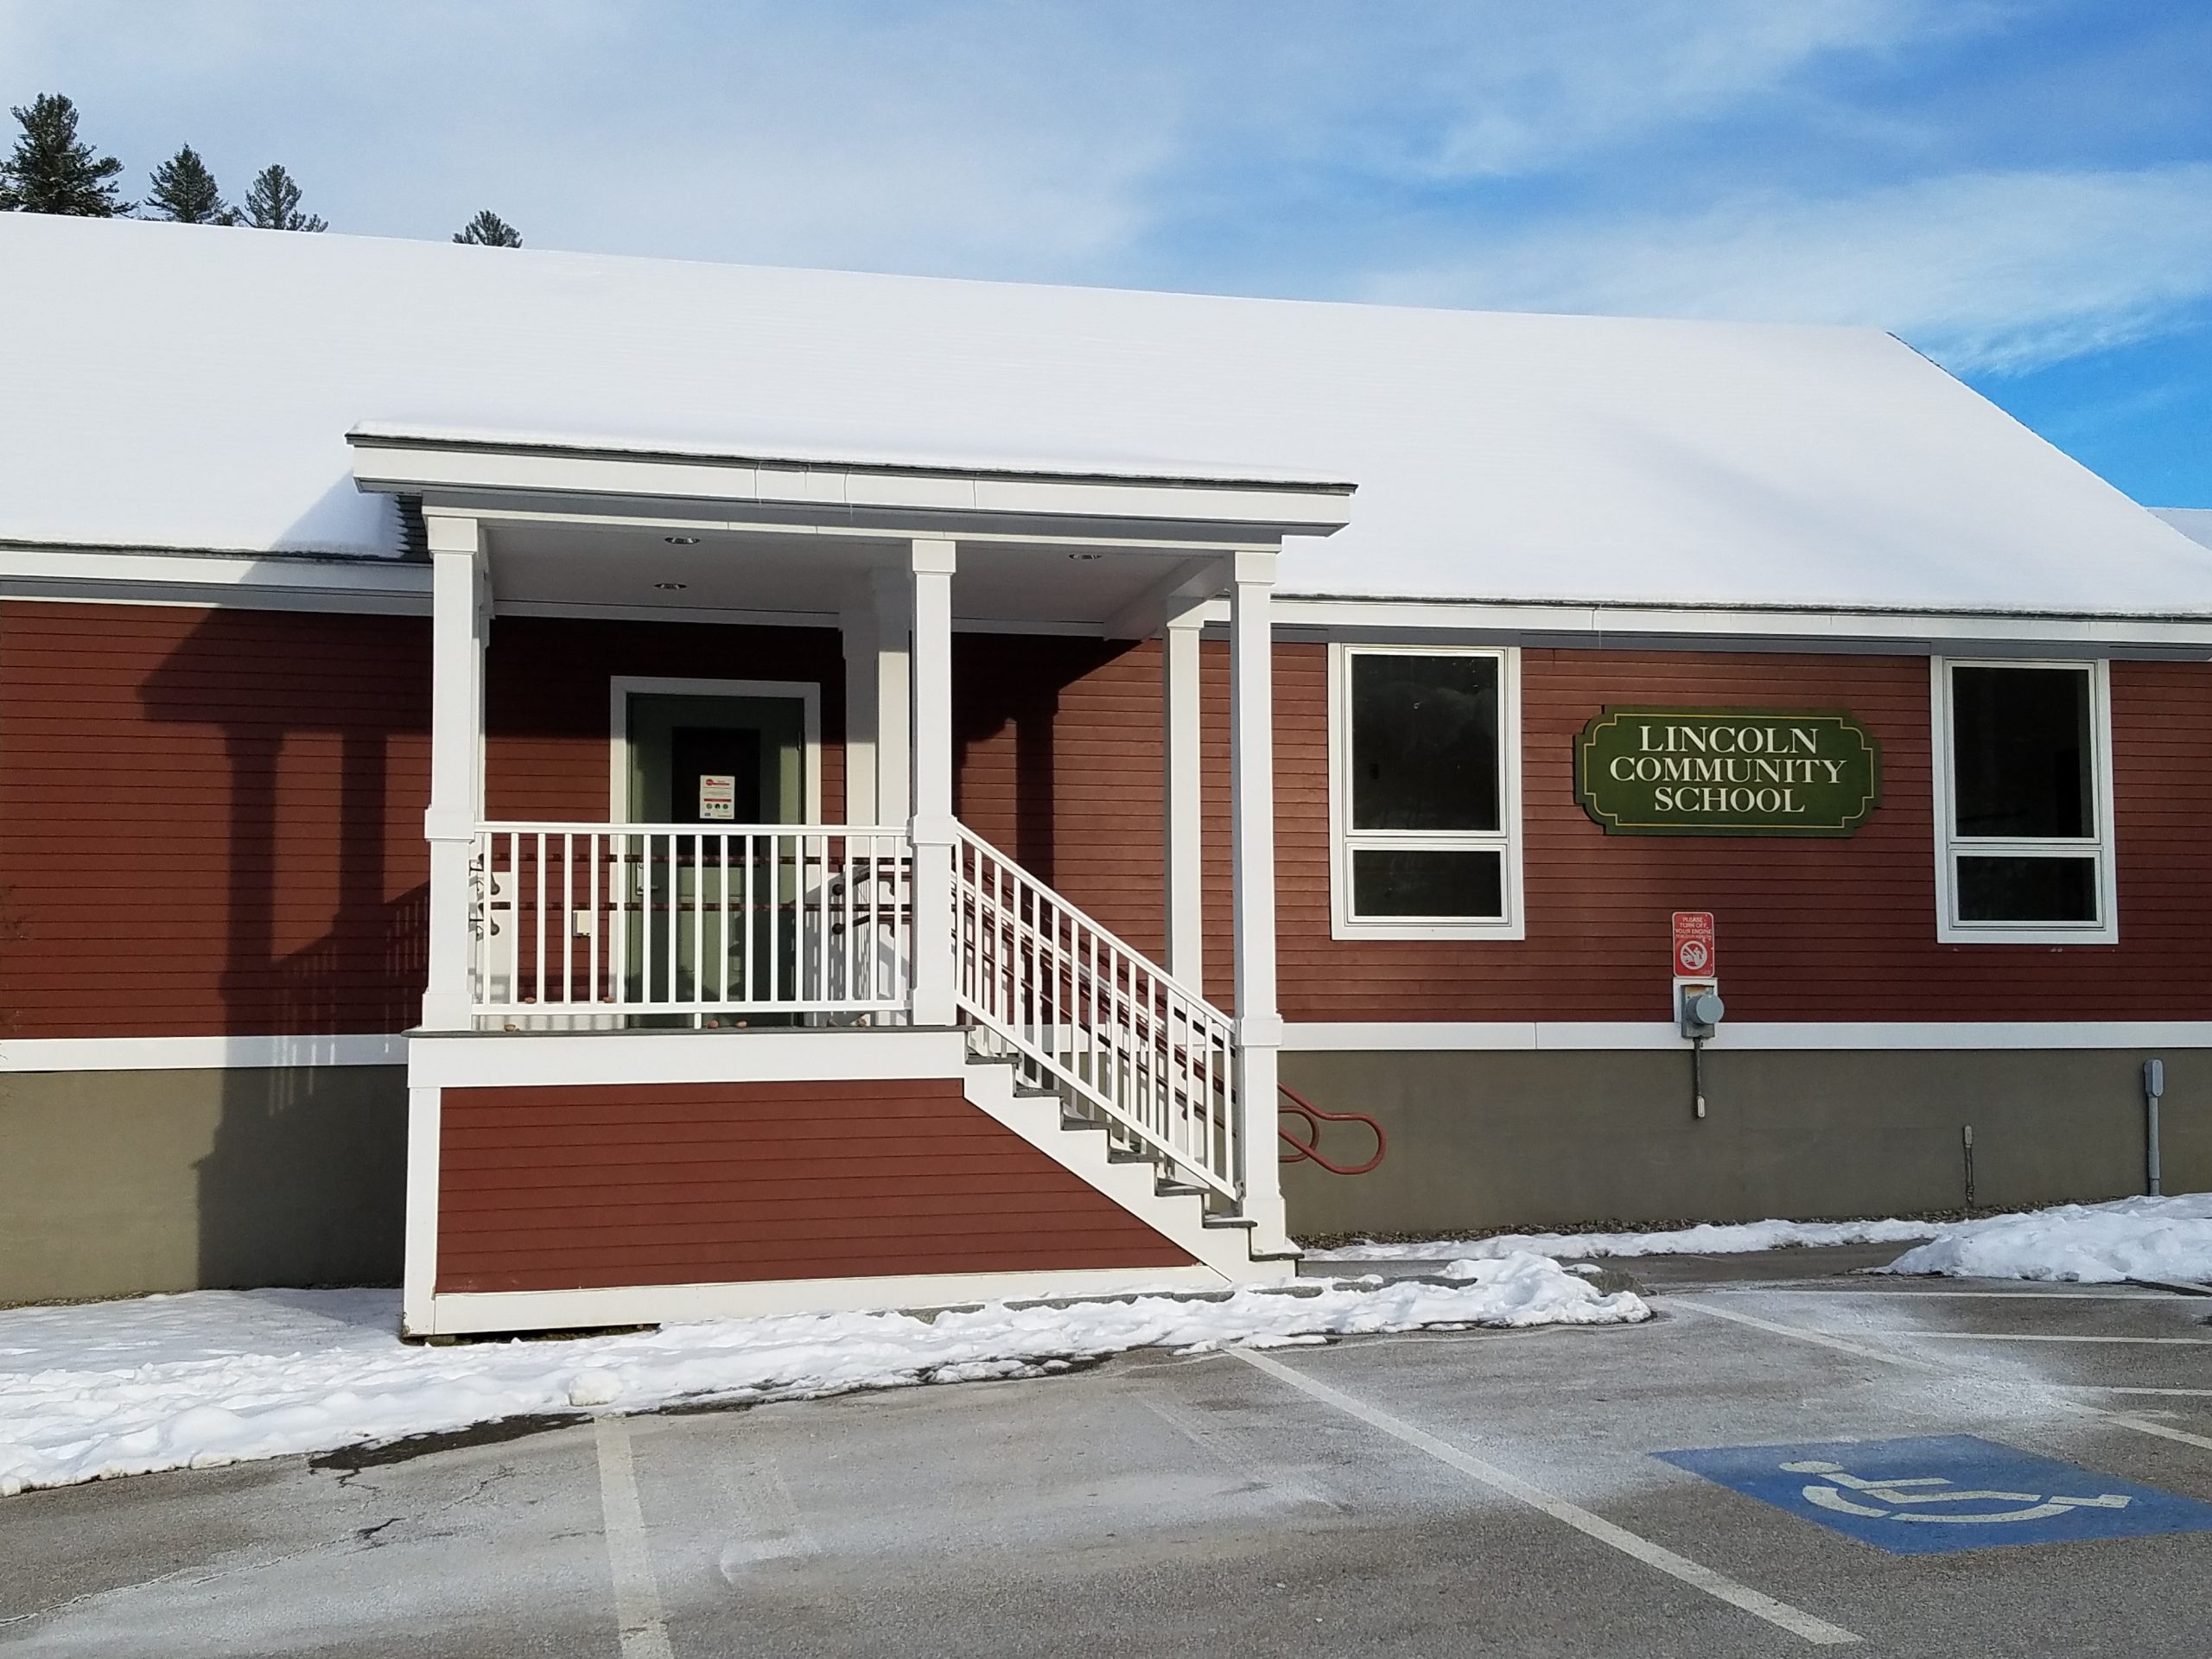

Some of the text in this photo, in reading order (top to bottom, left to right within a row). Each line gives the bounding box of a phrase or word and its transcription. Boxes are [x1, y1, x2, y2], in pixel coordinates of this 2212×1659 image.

[1639, 726, 1818, 753] LINCOLN
[1609, 756, 1847, 783] COMMUNITY
[1655, 787, 1806, 812] SCHOOL
